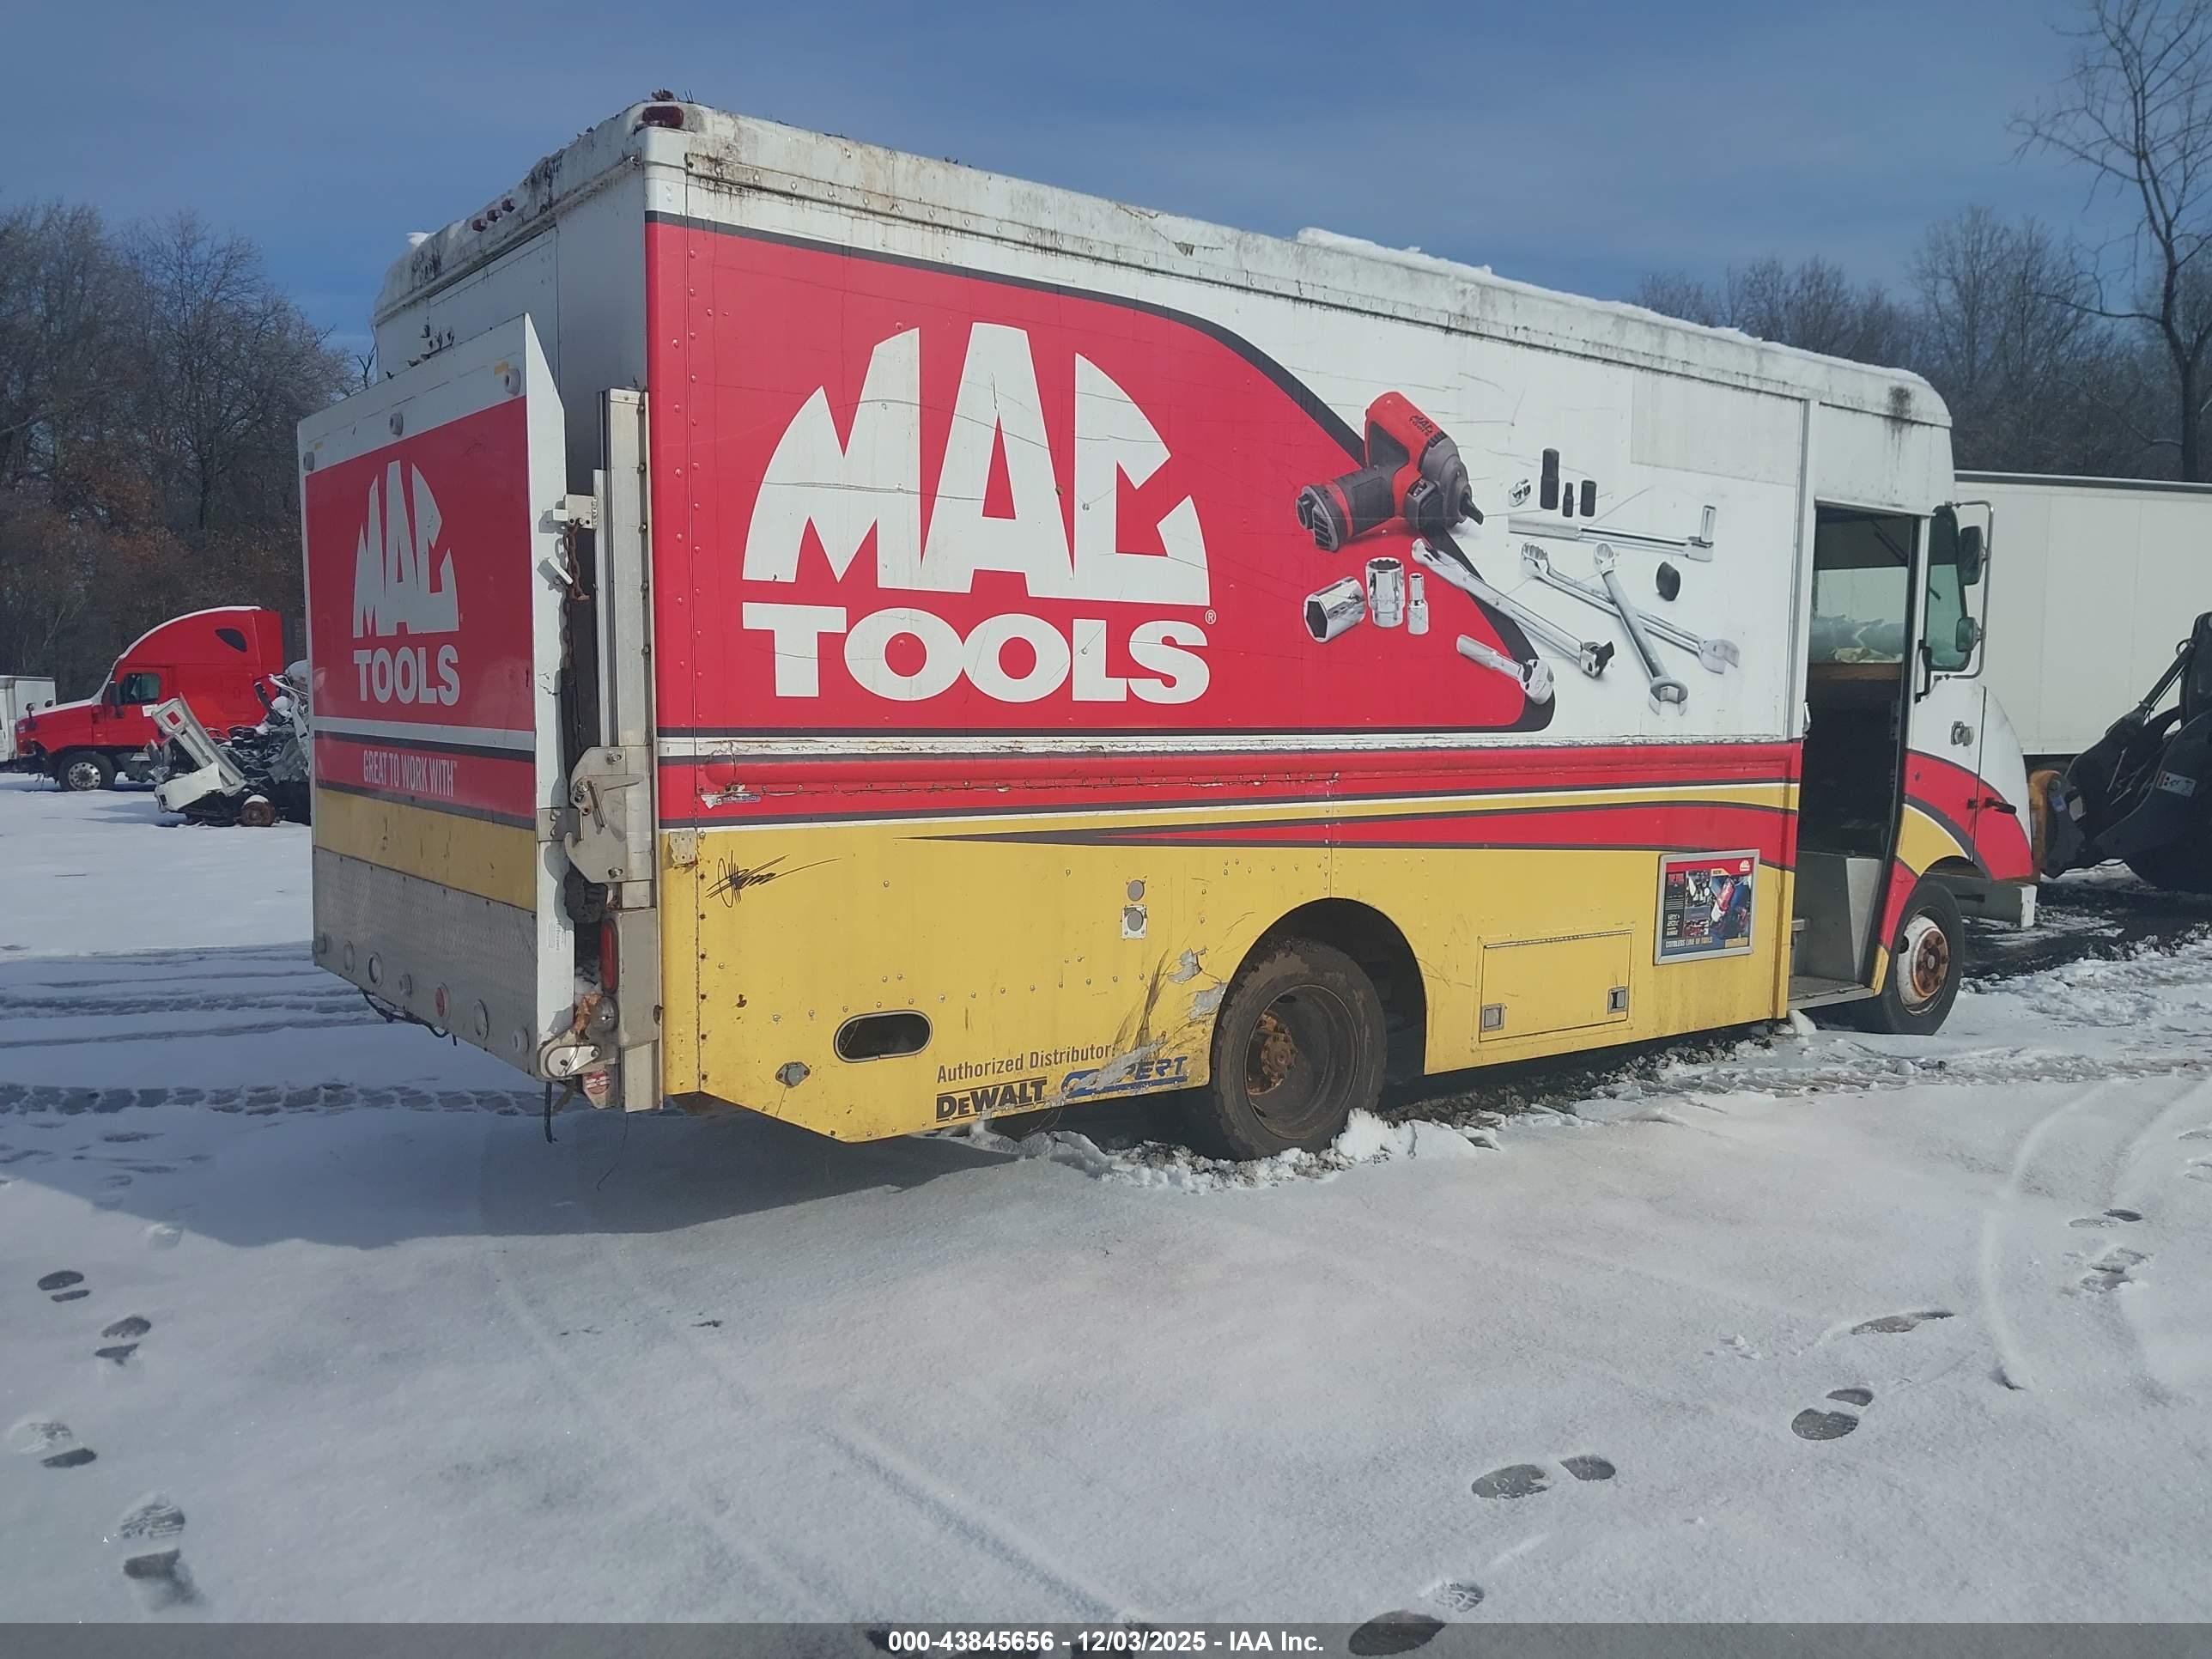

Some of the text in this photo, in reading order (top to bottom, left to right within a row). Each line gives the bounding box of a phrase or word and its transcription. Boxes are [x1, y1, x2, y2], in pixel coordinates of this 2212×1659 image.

[742, 321, 1211, 607] MAC
[353, 459, 459, 639] MAC
[353, 644, 460, 706] TOOLS
[742, 602, 1211, 705] TOOLS
[363, 750, 387, 786] GREAT
[389, 752, 399, 787] TO
[401, 754, 427, 793] WORK
[937, 1042, 1115, 1084] Authorized Distributor:
